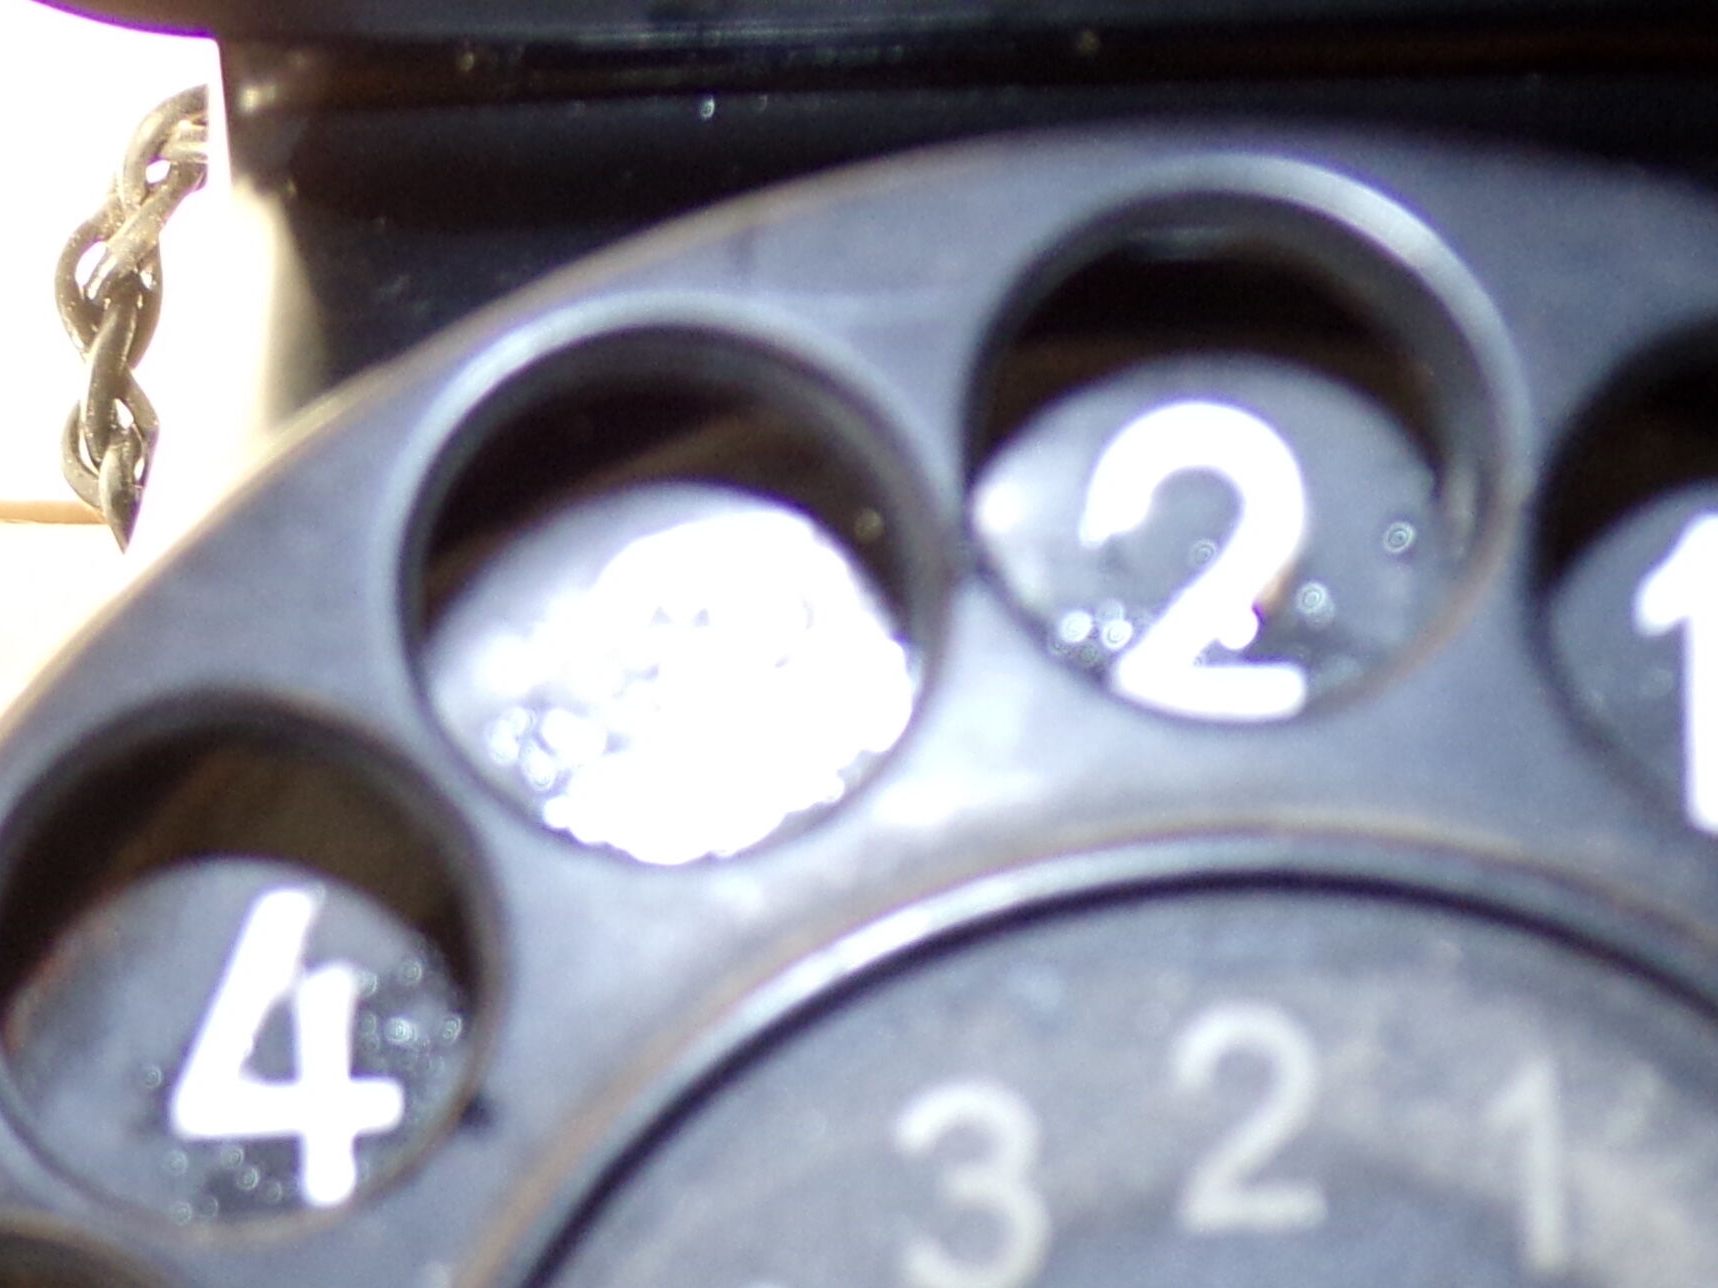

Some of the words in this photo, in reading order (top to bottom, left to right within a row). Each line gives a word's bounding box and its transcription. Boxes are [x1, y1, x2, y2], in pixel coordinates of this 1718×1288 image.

[1080, 399, 1307, 721] 2
[172, 887, 404, 1204] 4
[1172, 1003, 1328, 1232] 2
[1484, 1056, 1571, 1276] 1
